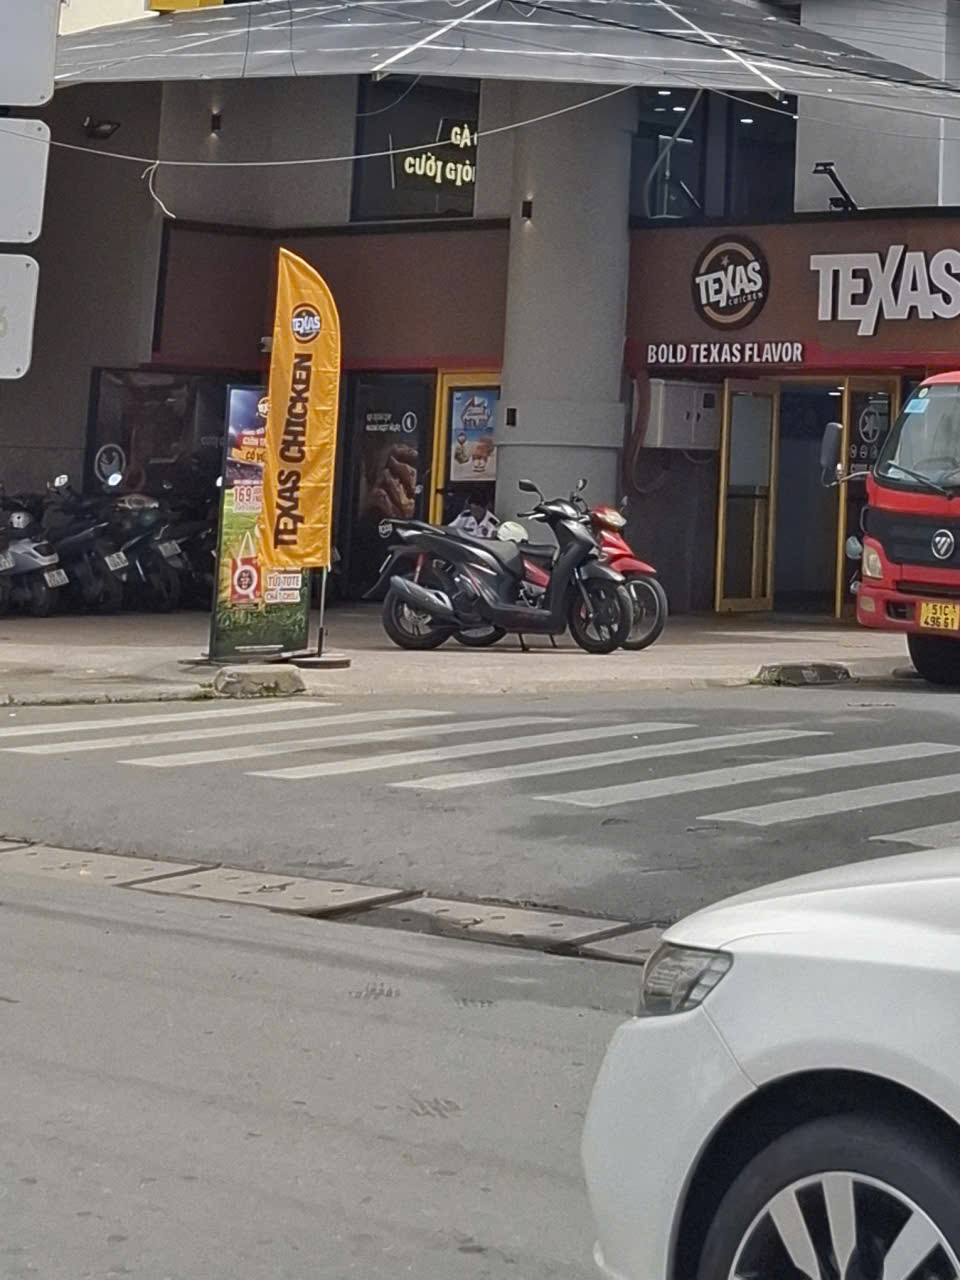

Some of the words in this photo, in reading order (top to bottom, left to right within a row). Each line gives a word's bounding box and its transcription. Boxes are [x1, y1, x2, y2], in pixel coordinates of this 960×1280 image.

[404, 151, 443, 184] CƯỜI
[695, 261, 763, 308] TEXAS
[728, 292, 764, 306] CHICKEN
[292, 315, 321, 335] TEXAS
[647, 344, 687, 364] BOLD
[690, 343, 741, 364] TEXAS
[744, 342, 803, 363] FLAVOR
[279, 352, 313, 463] CHICKEN
[234, 487, 251, 502] 169
[274, 469, 305, 549] TEXAS
[931, 604, 950, 616] 51C
